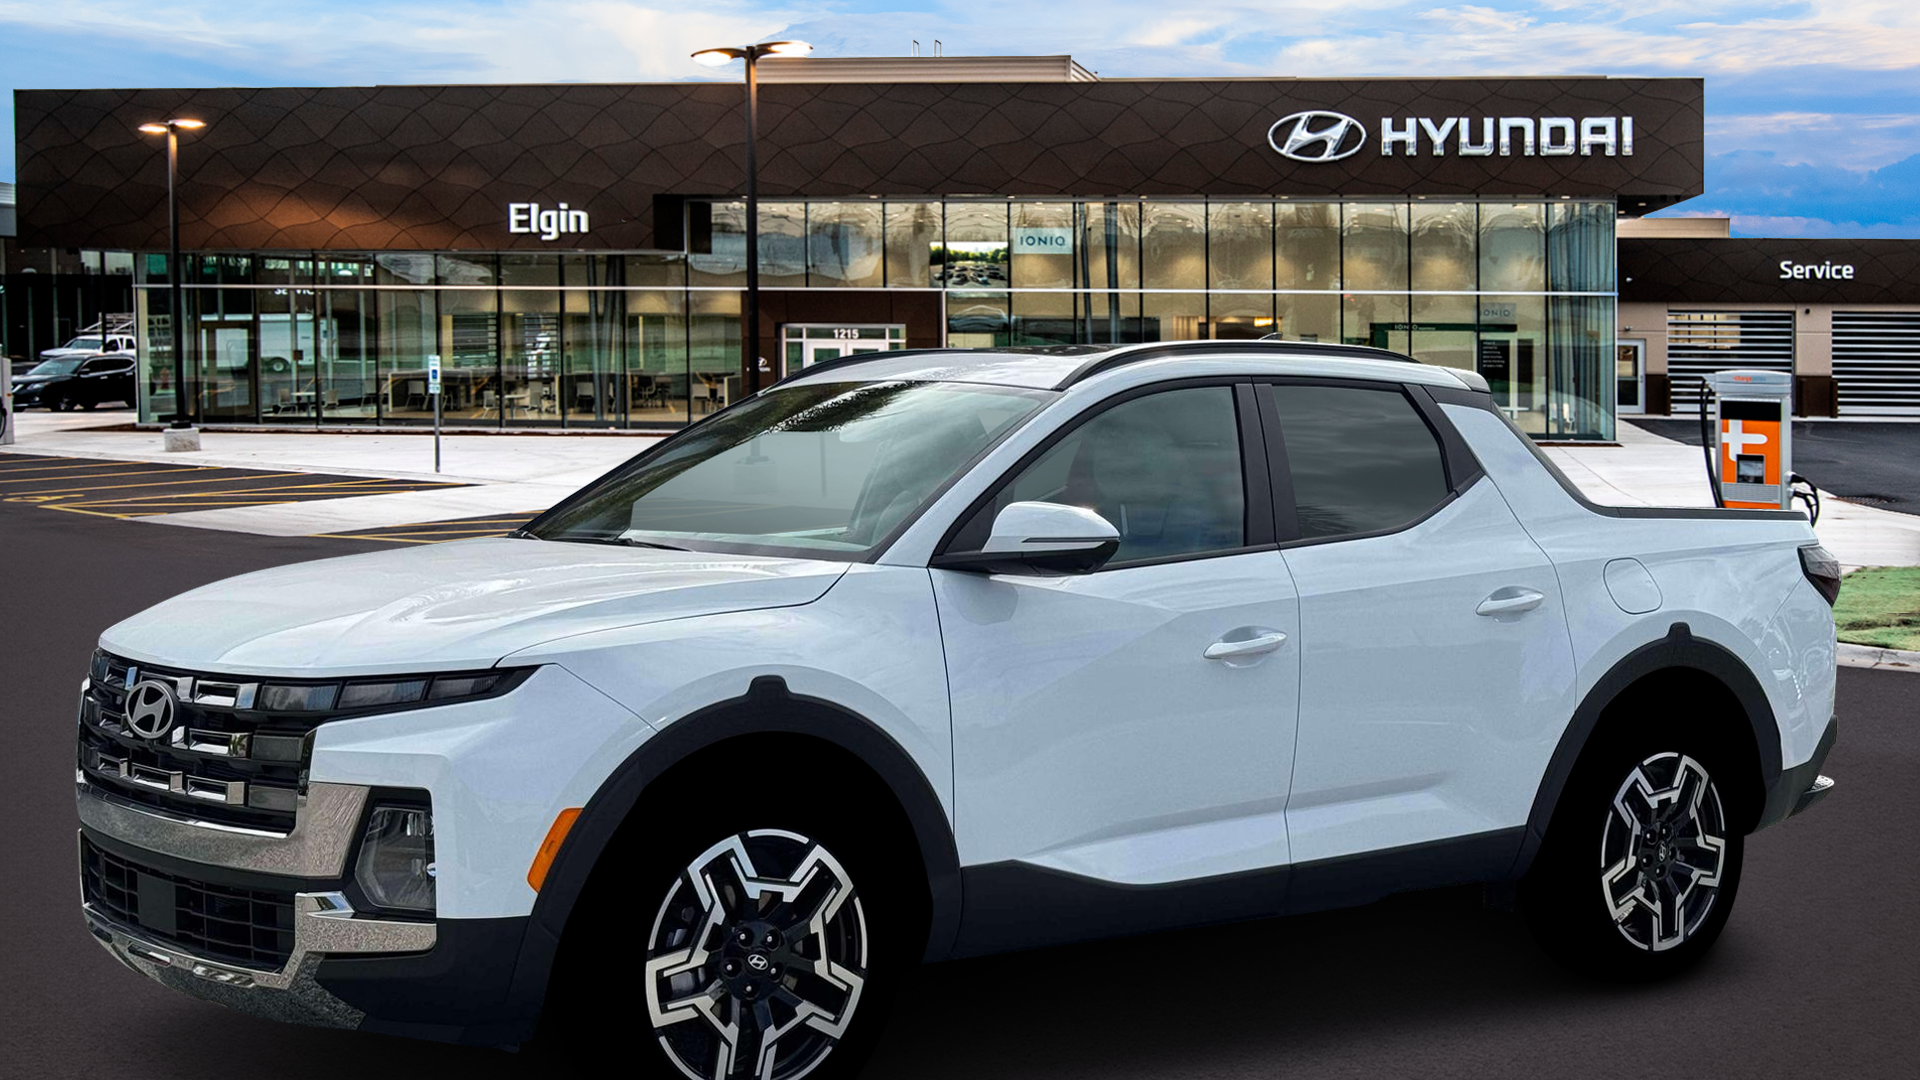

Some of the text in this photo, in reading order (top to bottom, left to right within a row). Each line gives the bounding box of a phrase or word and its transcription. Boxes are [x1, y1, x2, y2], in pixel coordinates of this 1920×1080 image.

[1381, 116, 1634, 157] HYUNDAI
[508, 202, 590, 241] Elgin
[1020, 235, 1066, 247] IONIQ
[1779, 260, 1855, 280] Service
[834, 329, 859, 339] 1215
